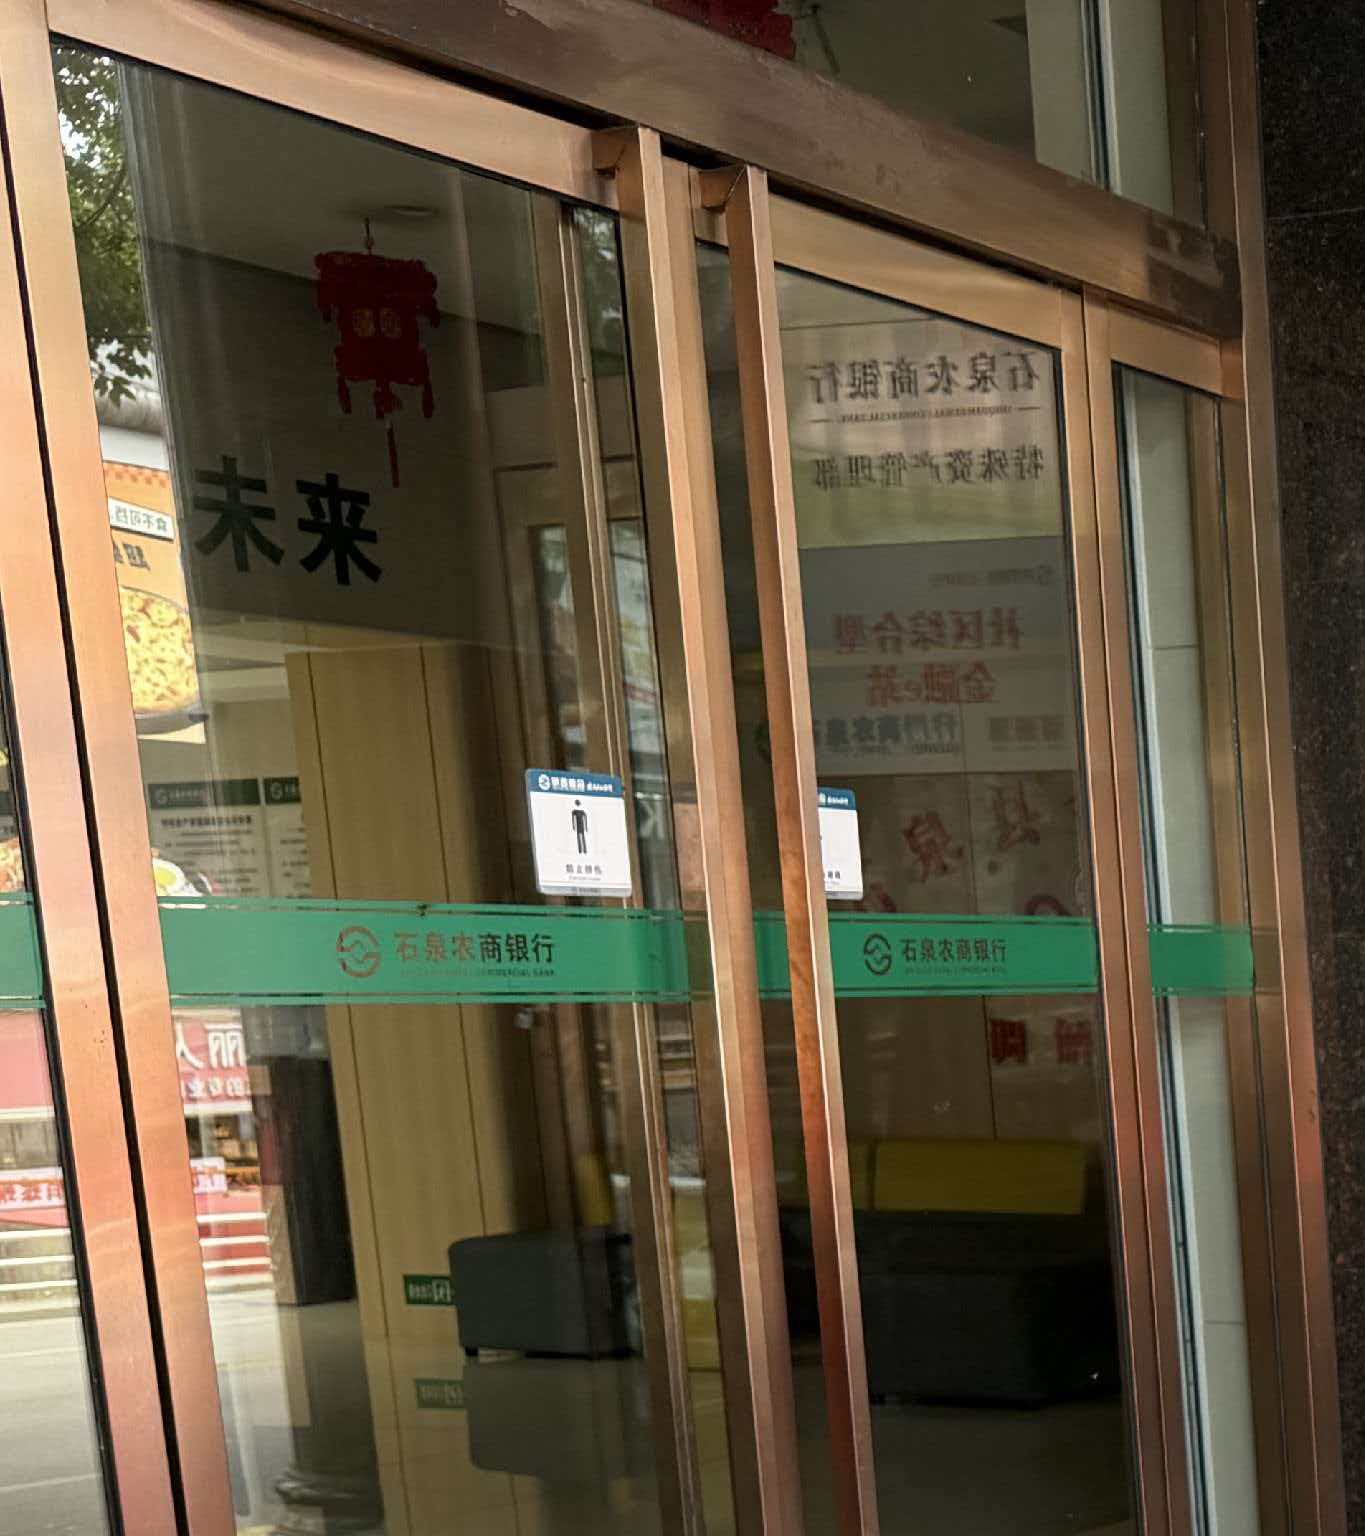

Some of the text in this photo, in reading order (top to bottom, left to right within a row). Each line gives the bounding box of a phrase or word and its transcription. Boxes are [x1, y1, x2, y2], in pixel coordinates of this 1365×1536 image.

[194, 454, 382, 586] 未来
[393, 930, 556, 963] 石泉农商银行
[901, 938, 1007, 963] 石泉农商银行
